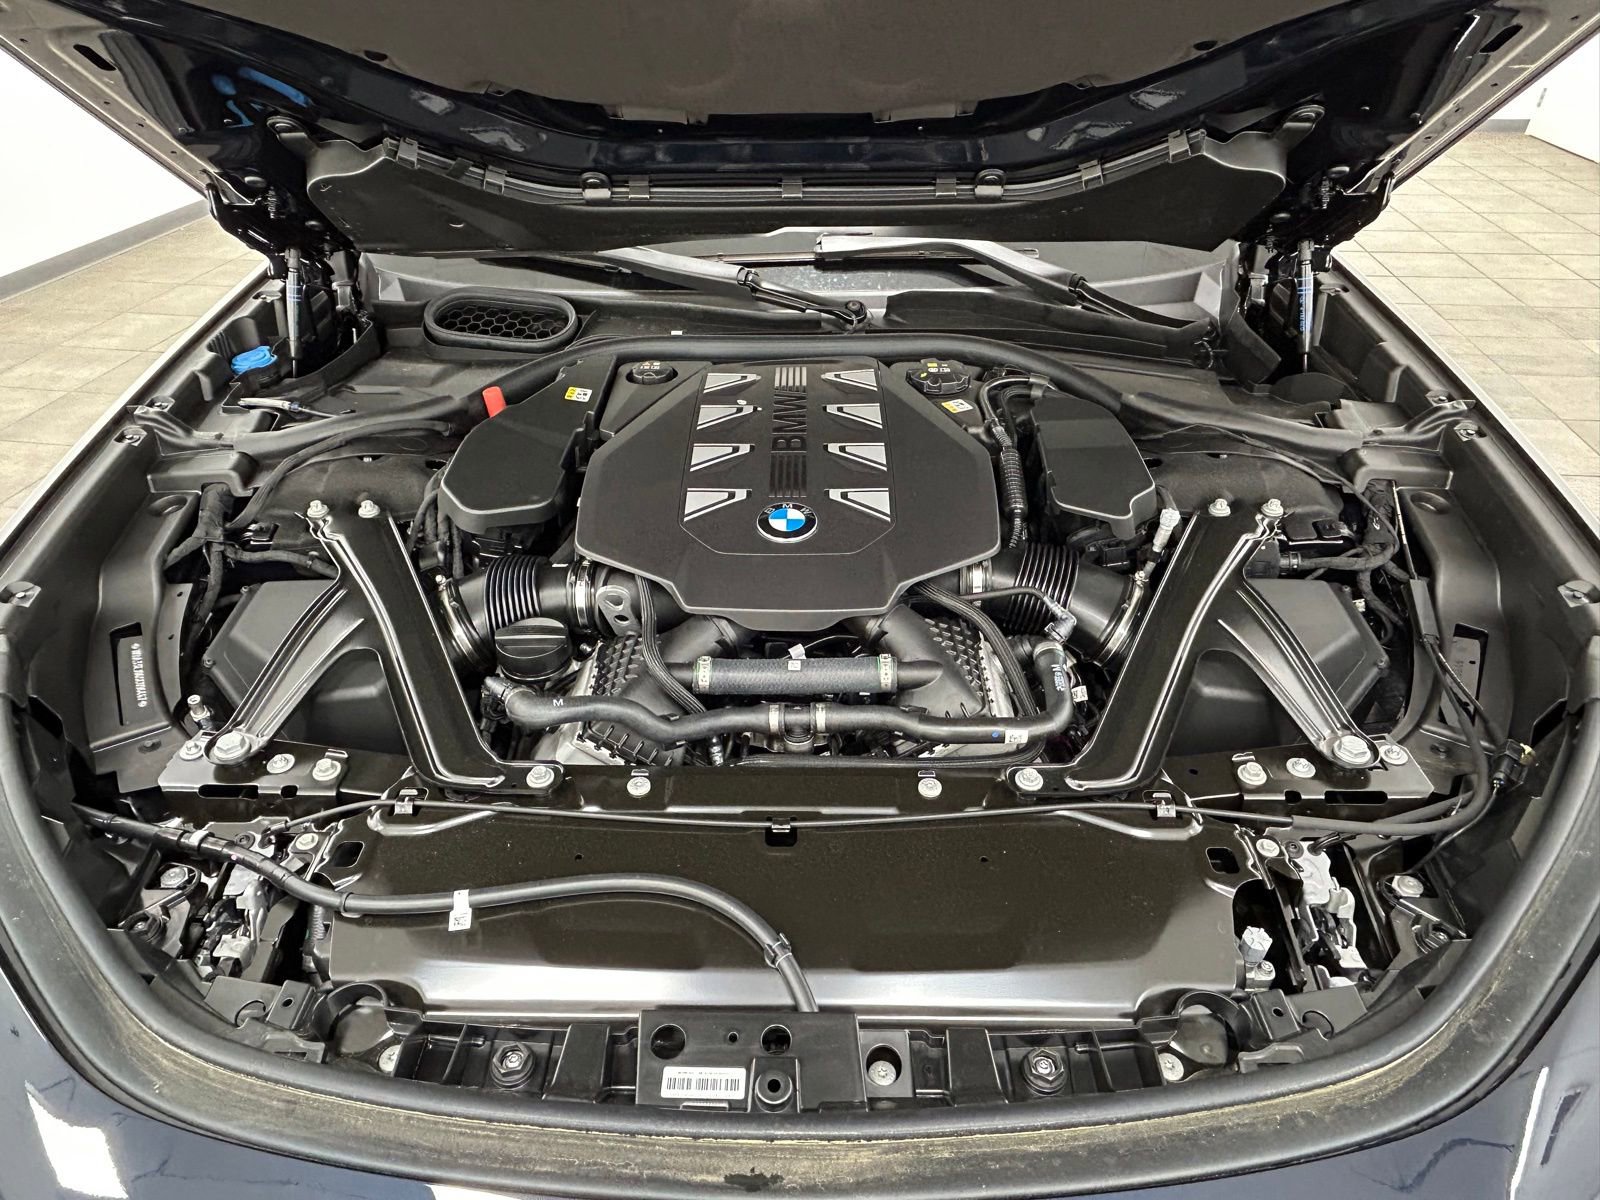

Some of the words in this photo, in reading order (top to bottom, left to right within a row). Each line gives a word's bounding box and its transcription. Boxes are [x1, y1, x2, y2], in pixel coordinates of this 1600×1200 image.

[771, 391, 807, 453] BMW
[764, 503, 812, 516] BMW
[552, 699, 564, 707] M
